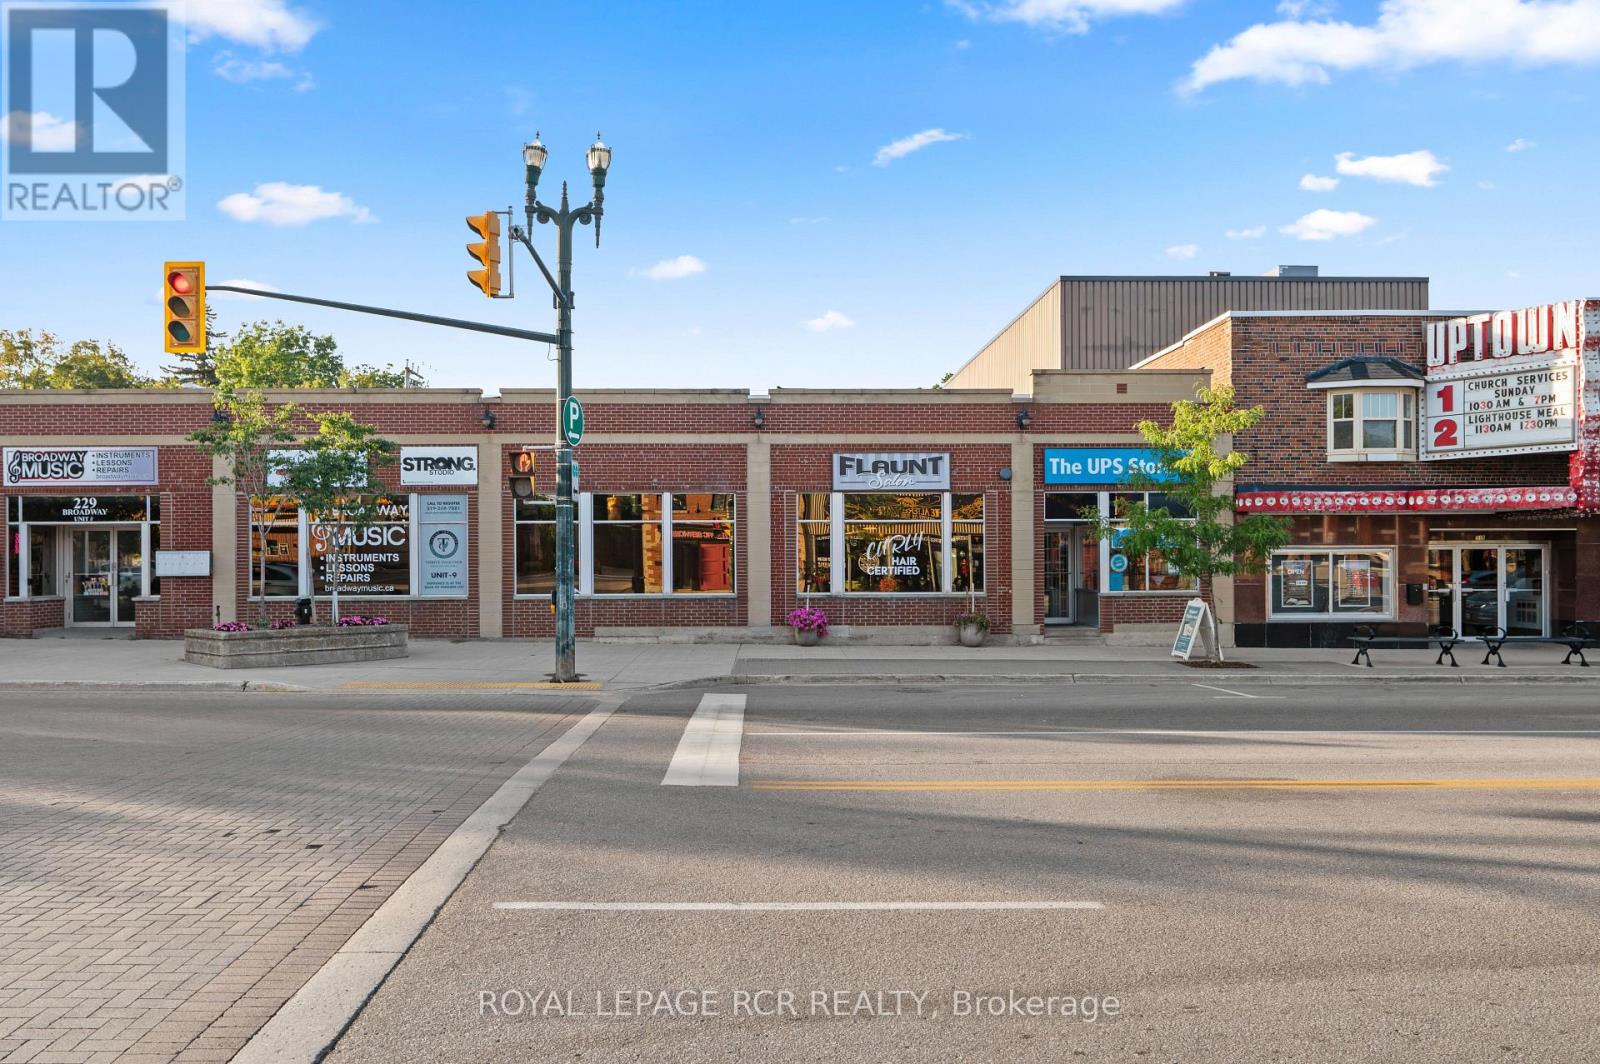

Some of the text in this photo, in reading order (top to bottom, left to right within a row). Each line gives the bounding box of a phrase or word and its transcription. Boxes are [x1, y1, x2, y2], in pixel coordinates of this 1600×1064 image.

[1427, 301, 1576, 367] UPTOWN
[1468, 371, 1568, 390] CHURCH SERVICES
[1437, 385, 1453, 412] 1
[1495, 386, 1535, 398] SUNDAY
[1518, 397, 1524, 406] &
[1535, 394, 1556, 404] 7PM
[570, 402, 579, 429] P
[1469, 407, 1566, 424] LIGHTHOUSE MEAL
[1434, 419, 1457, 447] 2
[22, 452, 86, 462] BROADWAY
[22, 462, 83, 478] MUSIC
[840, 456, 942, 475] FLAUNT
[1049, 458, 1082, 474] The
[1087, 458, 1123, 474] UPS
[73, 497, 97, 509] 229
[62, 508, 108, 516] BROADWAY
[332, 526, 406, 546] MUSIC
[326, 553, 400, 562] INSTRUMENTS
[892, 556, 917, 566] HAIR
[867, 566, 921, 576] CERTIFIED
[325, 585, 395, 593] bradwaymusic.ca
